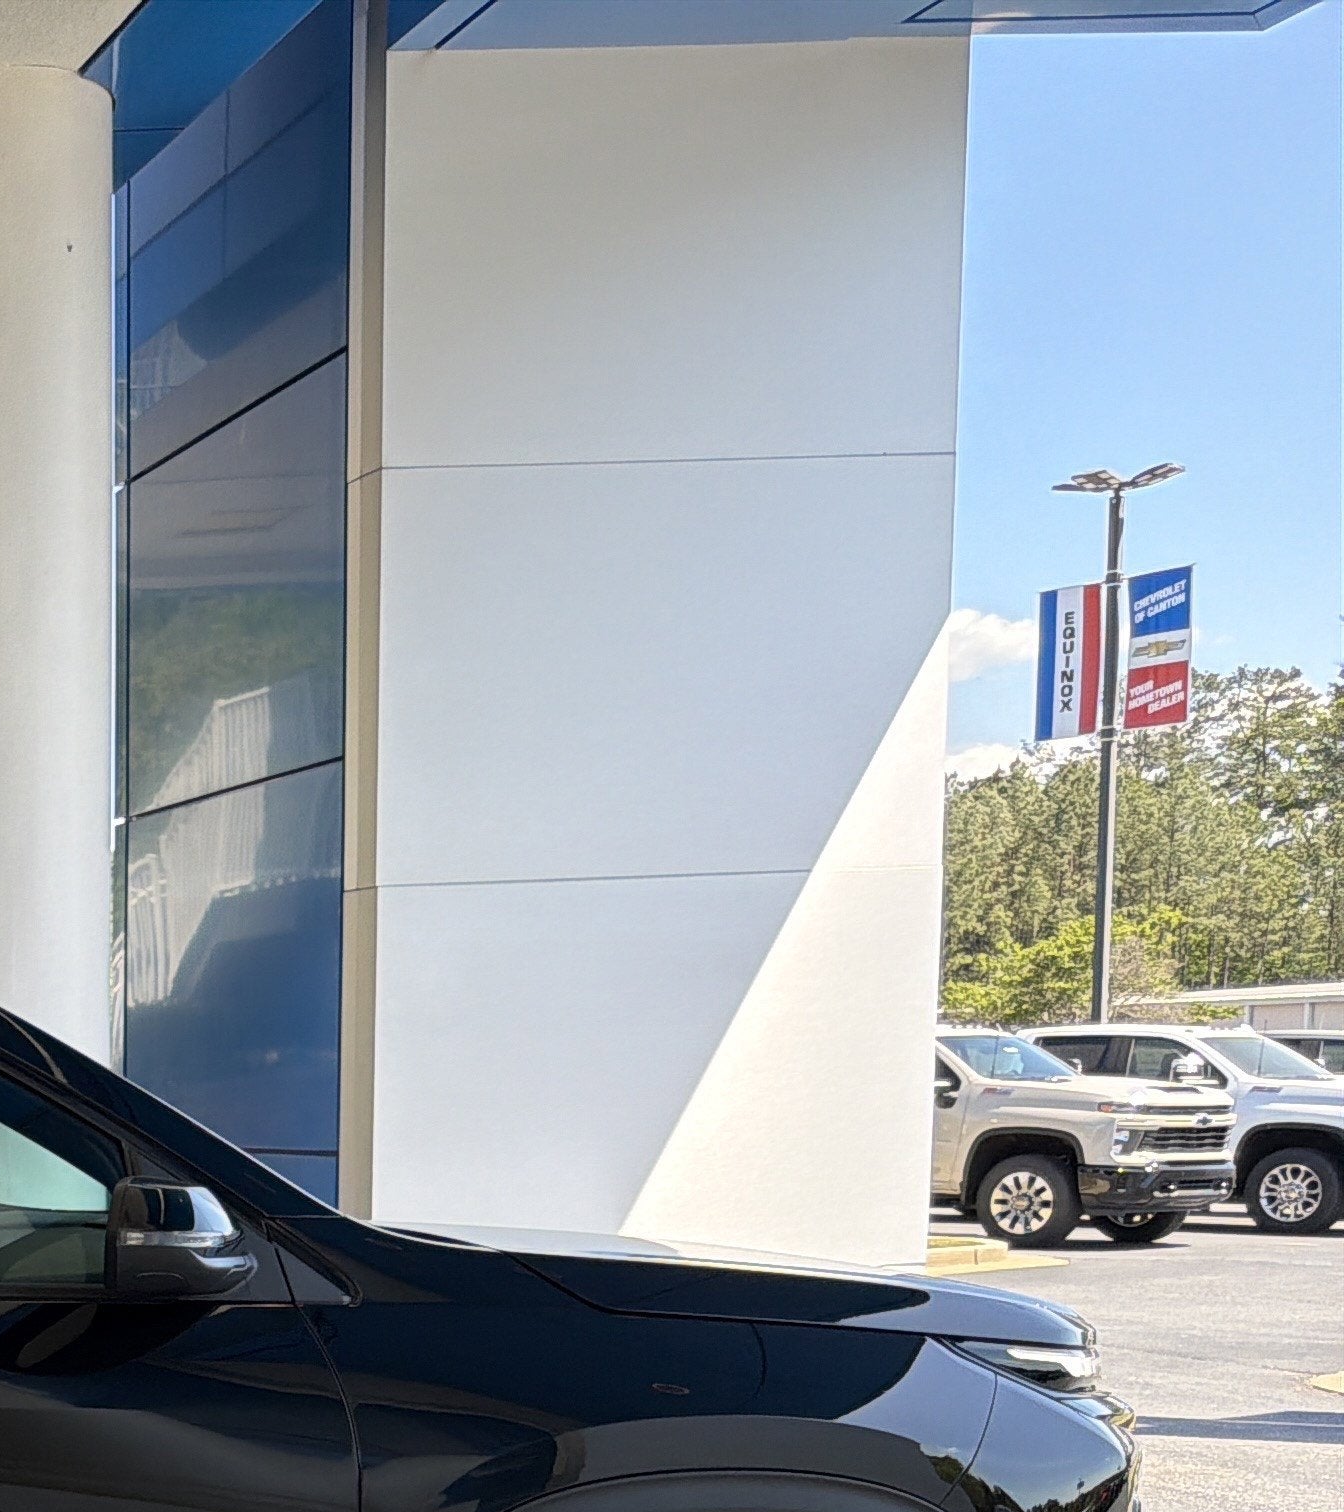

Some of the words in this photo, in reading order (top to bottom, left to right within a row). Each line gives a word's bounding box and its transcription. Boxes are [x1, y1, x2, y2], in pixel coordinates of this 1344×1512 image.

[1133, 579, 1187, 612] CHEVROLET
[1134, 611, 1146, 624] OF
[1147, 592, 1186, 618] CANTON
[1059, 611, 1075, 713] EQUINOX
[1127, 680, 1183, 711] HOMETOWN
[1129, 679, 1155, 698] YOUR
[1147, 691, 1185, 715] DEALER
